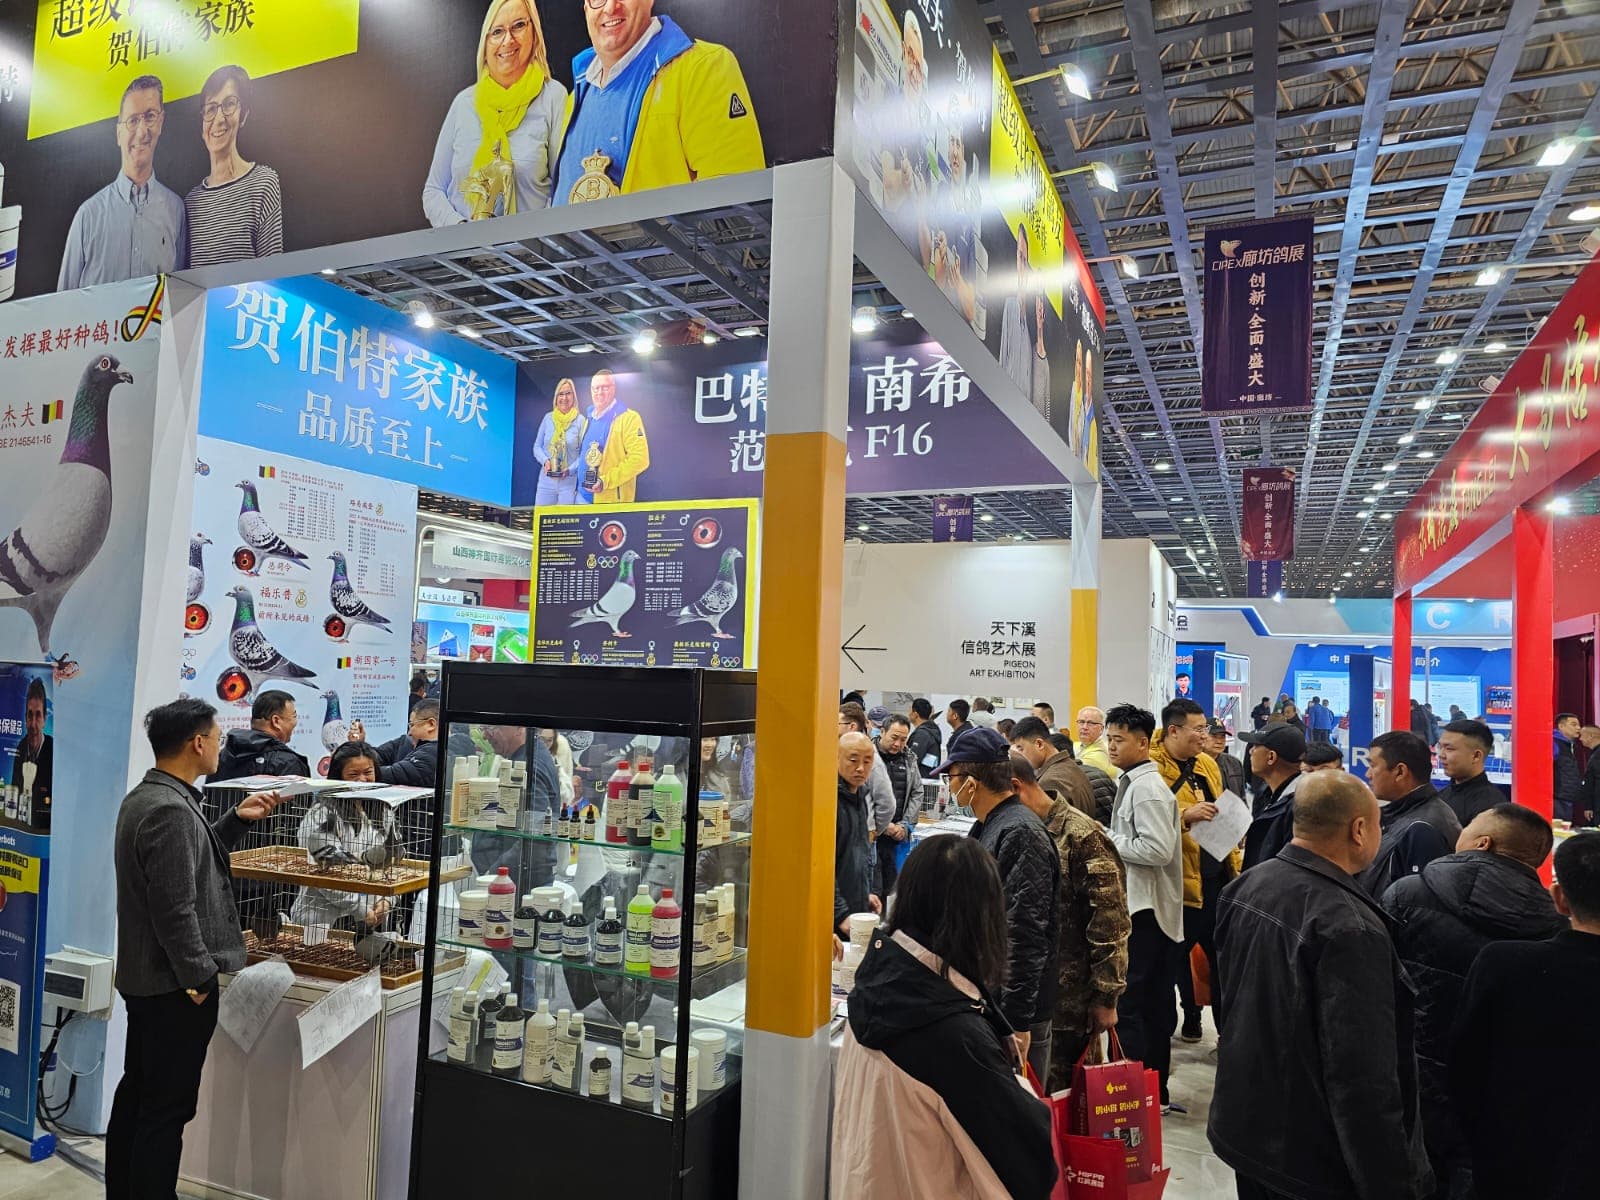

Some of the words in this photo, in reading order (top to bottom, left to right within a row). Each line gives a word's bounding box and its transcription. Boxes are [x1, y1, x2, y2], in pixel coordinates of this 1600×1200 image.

[225, 283, 490, 431] 贺伯特家族
[862, 353, 973, 415] 南希
[0, 401, 36, 430] 杰夫
[297, 389, 445, 470] 品质至上
[863, 420, 935, 459] F16
[990, 620, 1037, 637] 天下溪
[960, 640, 1037, 657] 信鸽艺术展
[969, 669, 986, 678] ART
[987, 669, 1036, 679] EXHIBITION
[1003, 660, 1036, 669] PIGEON
